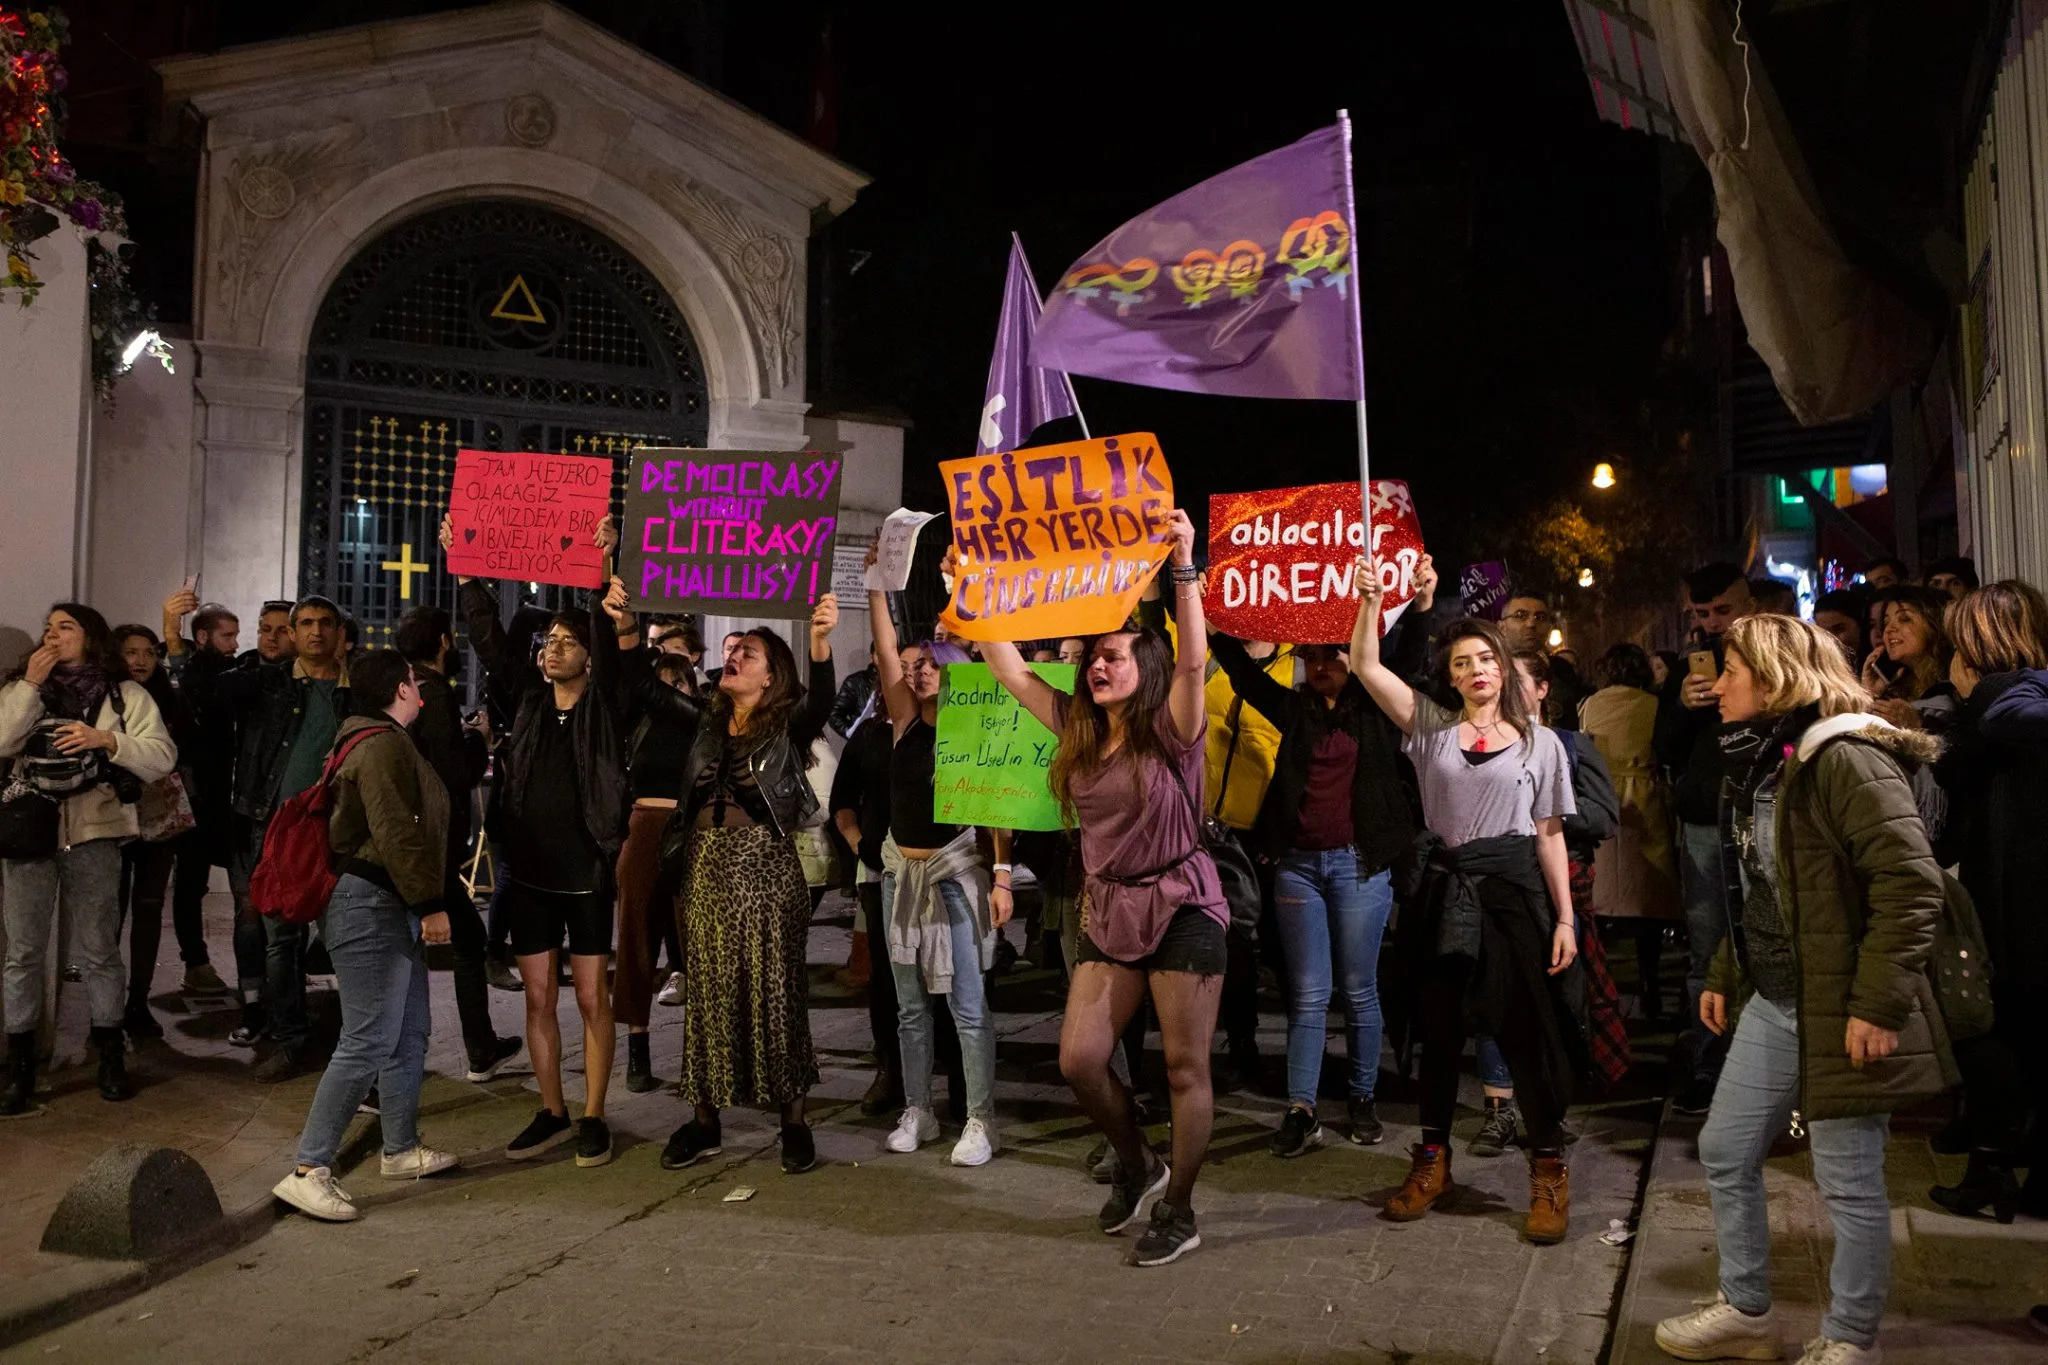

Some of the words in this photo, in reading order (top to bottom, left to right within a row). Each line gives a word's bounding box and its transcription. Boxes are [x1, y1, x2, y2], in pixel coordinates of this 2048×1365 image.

[524, 459, 599, 487] HETERO
[641, 459, 839, 500] DEMOCRASY
[954, 438, 1165, 522] EŞİTLİK
[465, 481, 562, 504] OLACAĞIZ
[667, 495, 768, 521] WITHOUT
[474, 501, 565, 529] İÇİMİZDEN
[568, 508, 597, 535] BİR
[954, 516, 1037, 564] HER
[1035, 498, 1169, 554] YERDE
[1230, 508, 1395, 551] ablacılar
[481, 525, 555, 551] İBNELİK
[641, 516, 836, 557] CLITERACY?
[485, 550, 563, 574] GELİYOR
